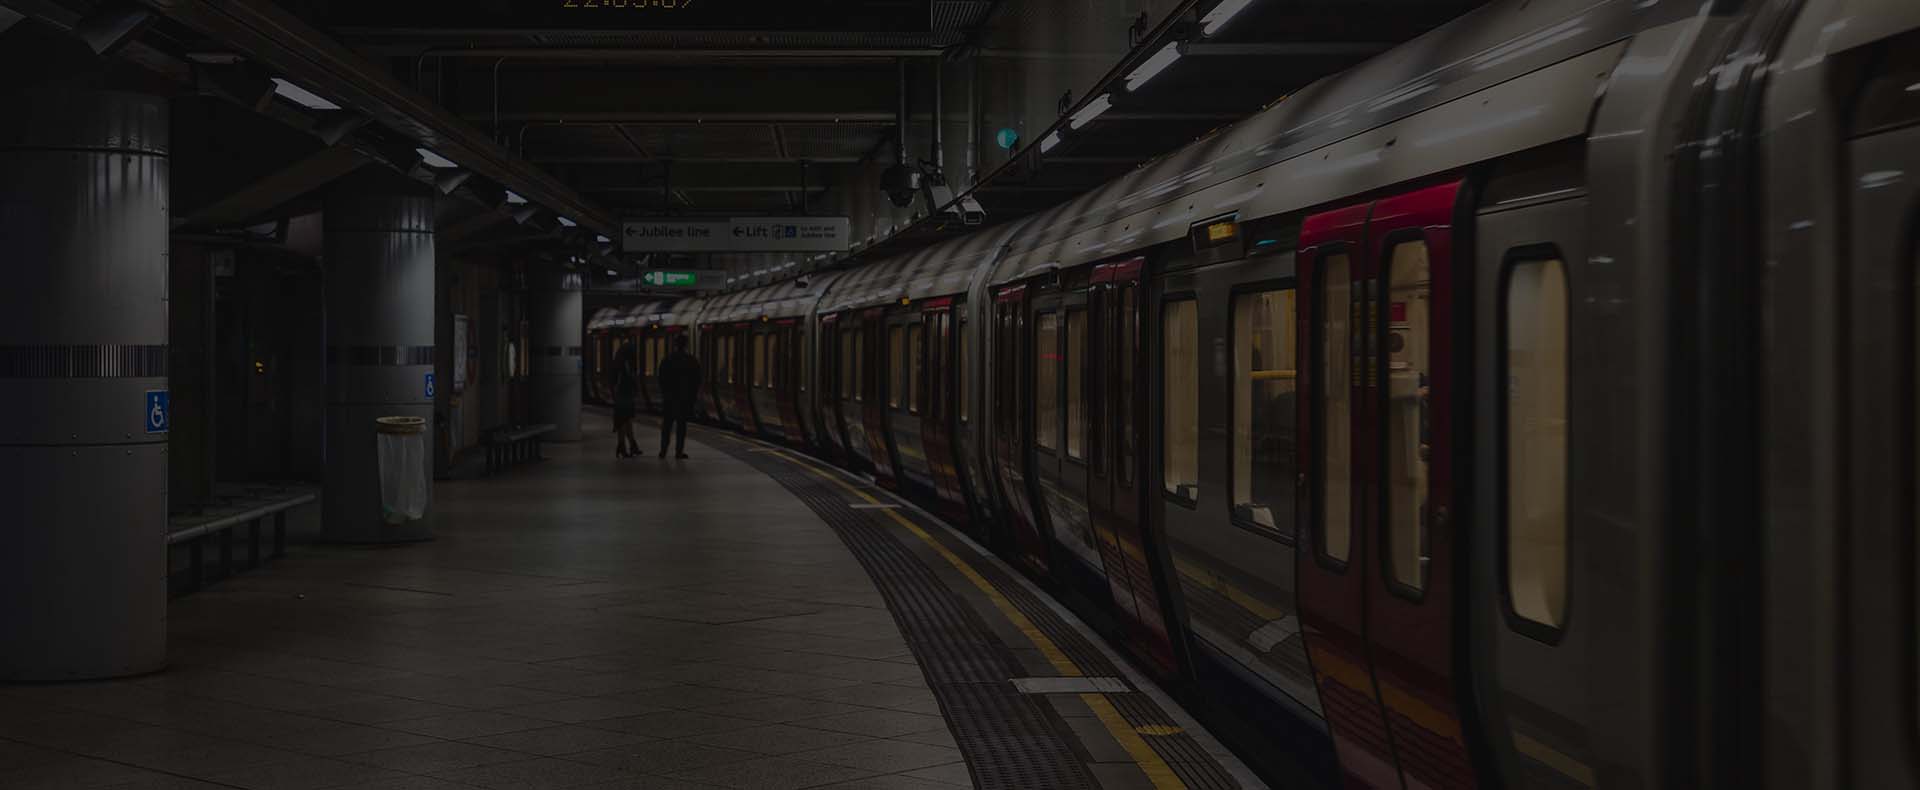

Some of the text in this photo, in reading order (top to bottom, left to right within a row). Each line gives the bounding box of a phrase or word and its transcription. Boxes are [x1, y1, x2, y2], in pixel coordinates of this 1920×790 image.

[639, 224, 711, 237] Jubilee line
[746, 224, 768, 237] Lift
